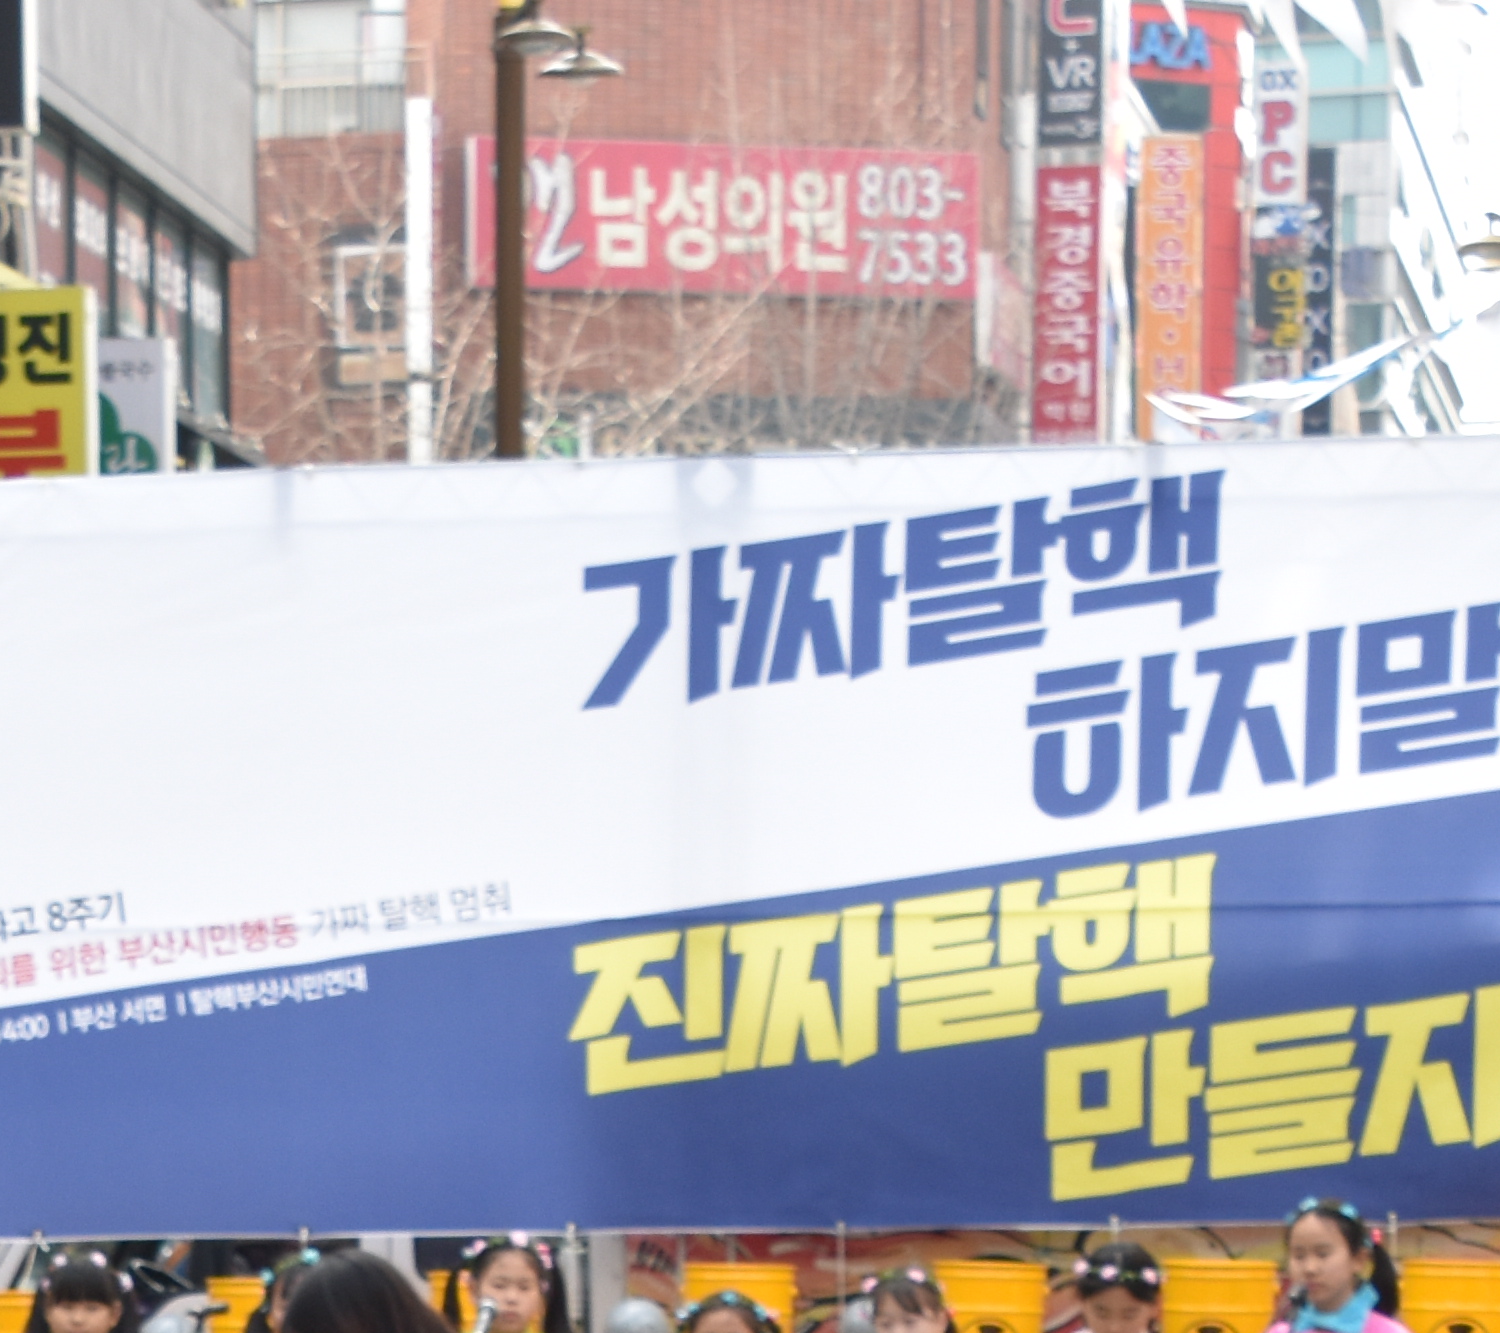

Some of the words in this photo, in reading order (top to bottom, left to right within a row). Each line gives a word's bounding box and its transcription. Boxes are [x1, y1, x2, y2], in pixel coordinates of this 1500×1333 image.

[1046, 56, 1097, 90] VR
[1260, 100, 1296, 196] PC
[588, 165, 850, 275] 남성의원
[857, 230, 967, 286] 7533
[1150, 143, 1192, 322] 중국유학
[1040, 178, 1096, 400] 북경중국어
[582, 468, 1228, 710] 가짜탈핵
[46, 890, 127, 934] 8주기
[49, 940, 108, 978] 위한
[118, 912, 299, 969] 부산시민행동
[309, 901, 371, 938] 가짜
[378, 890, 441, 932] 탈핵
[449, 880, 514, 923] 멈춰
[568, 852, 1218, 1097] 진짜탈핵
